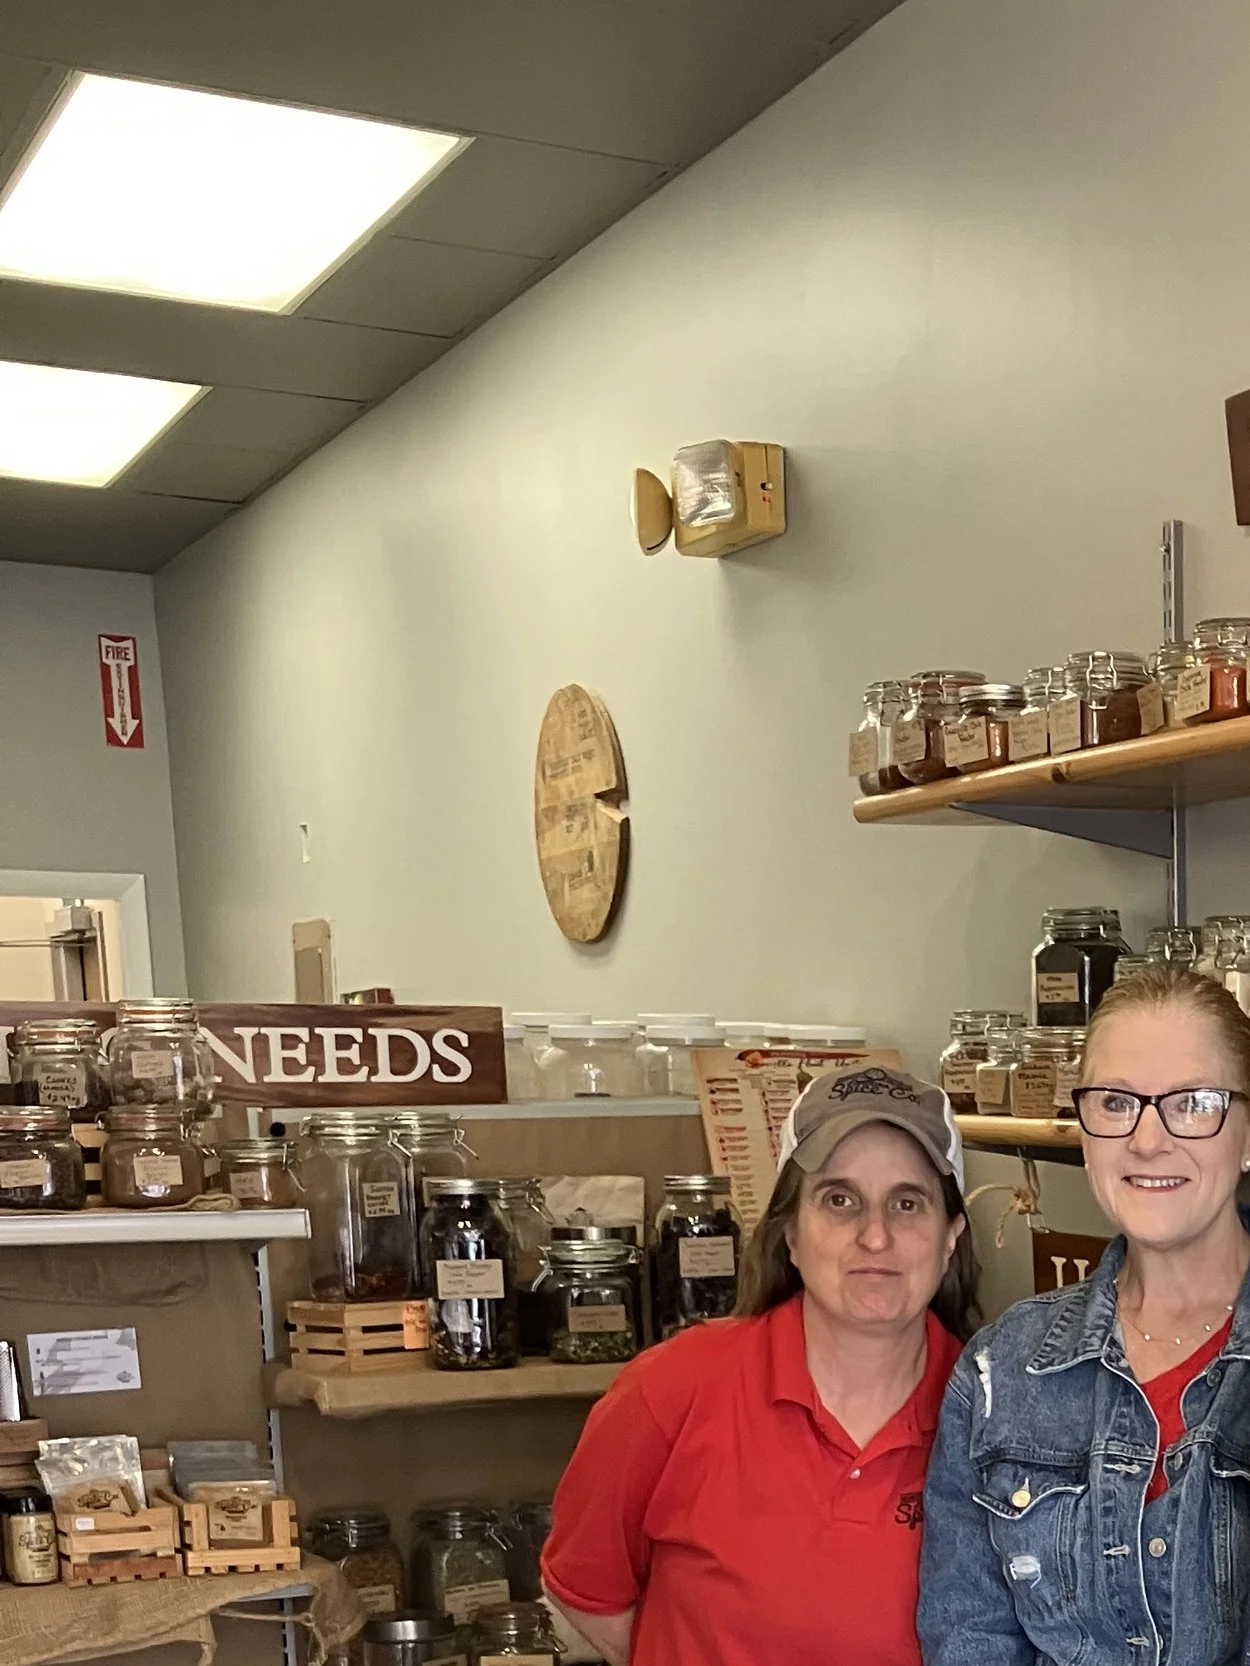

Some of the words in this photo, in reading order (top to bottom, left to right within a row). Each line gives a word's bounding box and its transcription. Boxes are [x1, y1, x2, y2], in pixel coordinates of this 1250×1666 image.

[104, 645, 132, 661] FIRE
[206, 1026, 473, 1084] NEEDS
[828, 1083, 884, 1102] Spice
